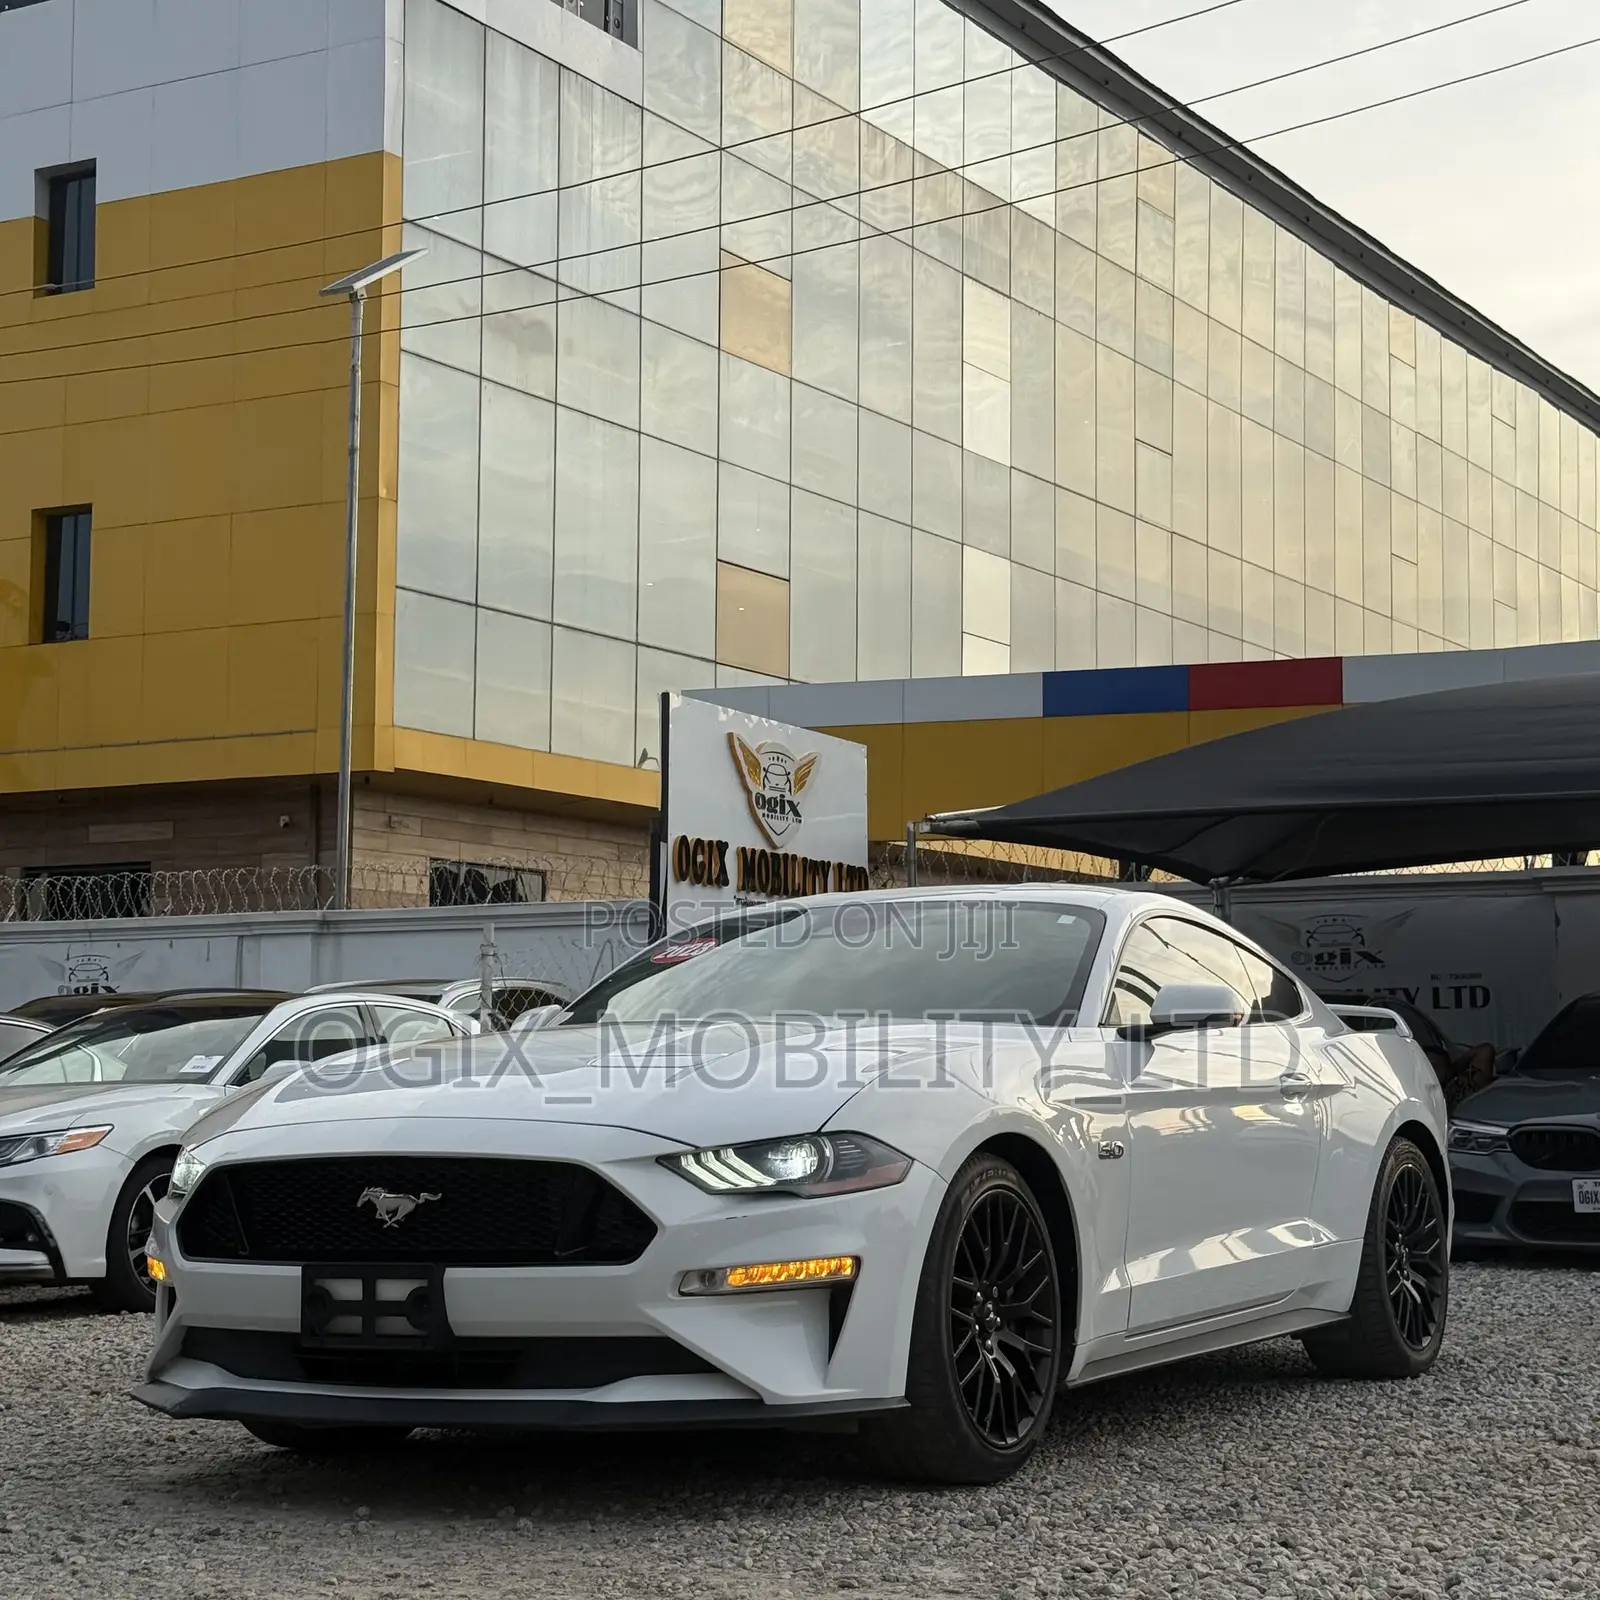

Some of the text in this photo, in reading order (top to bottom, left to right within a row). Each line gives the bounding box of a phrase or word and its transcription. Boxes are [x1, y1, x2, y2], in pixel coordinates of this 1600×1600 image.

[673, 835, 729, 888] OGIX
[736, 846, 832, 895] MOBILITY
[1432, 985, 1491, 1009] LTD
